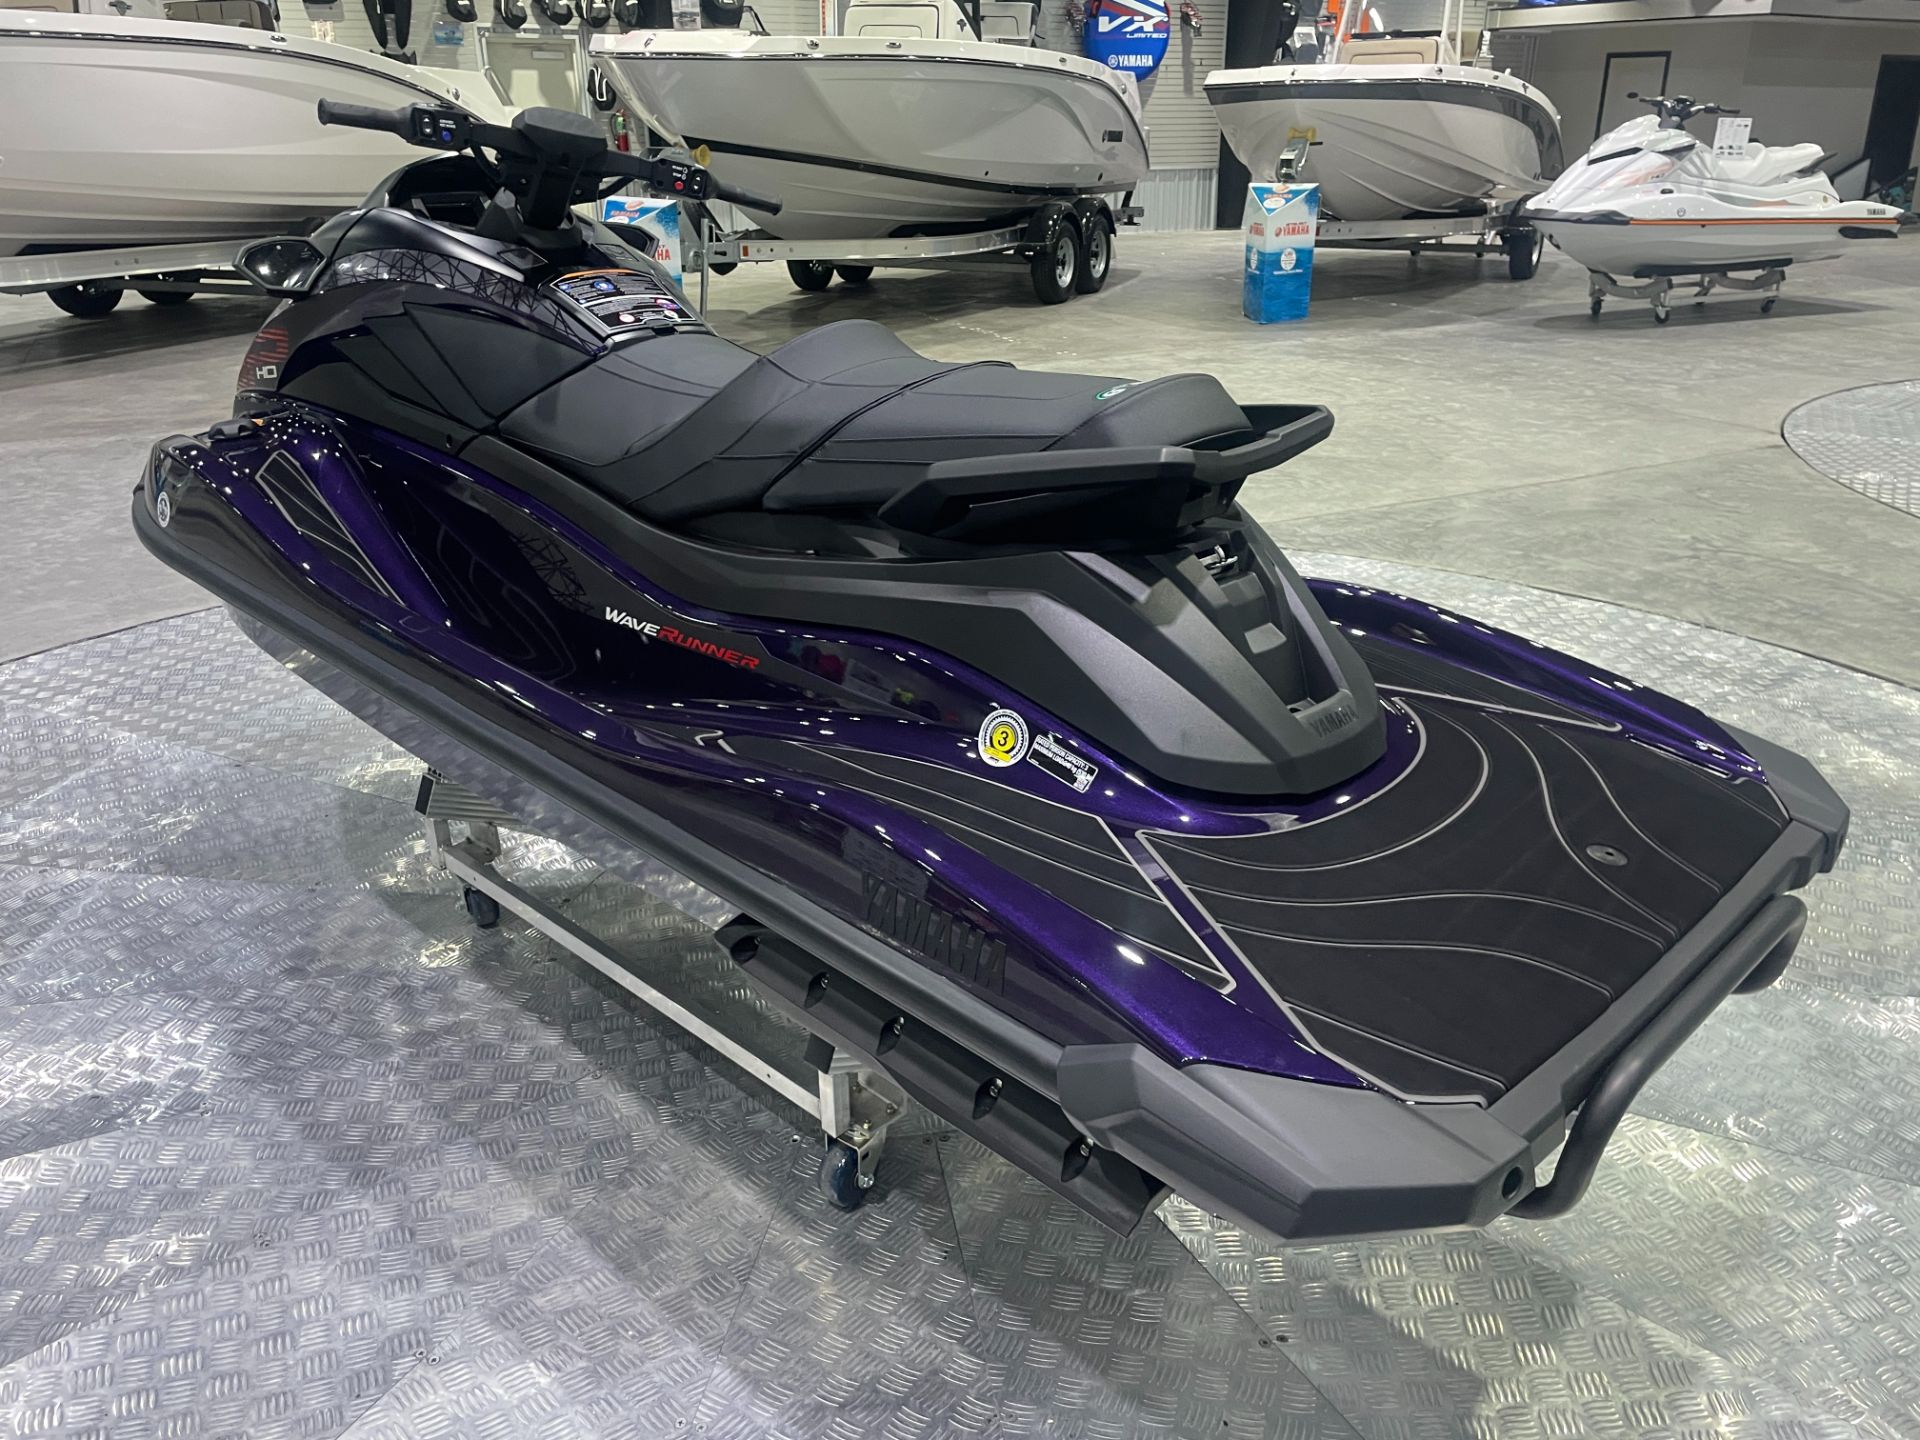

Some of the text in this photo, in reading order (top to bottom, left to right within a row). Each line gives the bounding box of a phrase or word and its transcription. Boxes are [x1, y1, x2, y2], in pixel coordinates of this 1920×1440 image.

[1118, 55, 1153, 67] YAMAHA
[1283, 224, 1310, 237] YAMAHA
[605, 606, 760, 670] WAVERUNNER
[1310, 703, 1359, 738] YAMAHA
[998, 730, 1009, 747] 3
[862, 868, 1007, 998] YAMAHA
